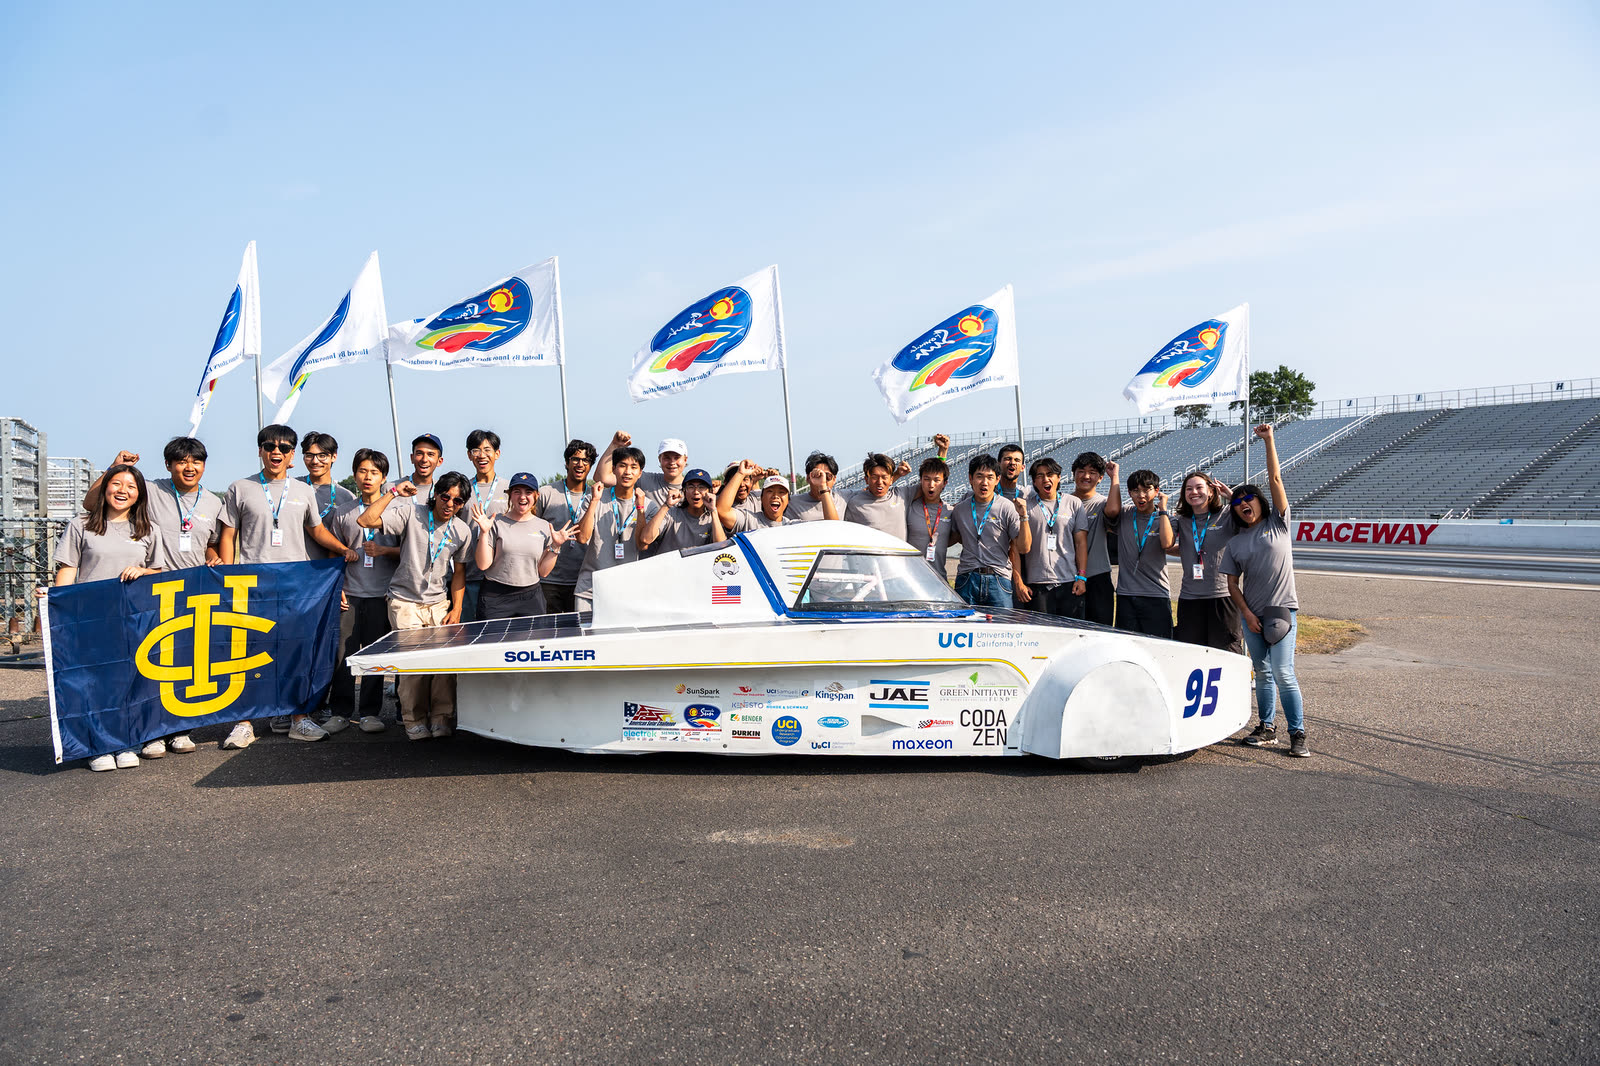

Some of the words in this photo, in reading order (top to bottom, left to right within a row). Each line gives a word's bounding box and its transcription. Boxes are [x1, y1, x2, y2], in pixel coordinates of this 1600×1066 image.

[1296, 522, 1439, 545] RACEWAY
[938, 632, 973, 648] UCI
[504, 650, 595, 662] SOLEATER
[815, 691, 854, 701] Kingspan
[870, 688, 929, 702] JAE
[1183, 668, 1222, 718] 95
[777, 720, 797, 729] UCI
[960, 710, 1007, 726] CODA
[893, 739, 952, 749] maxeon
